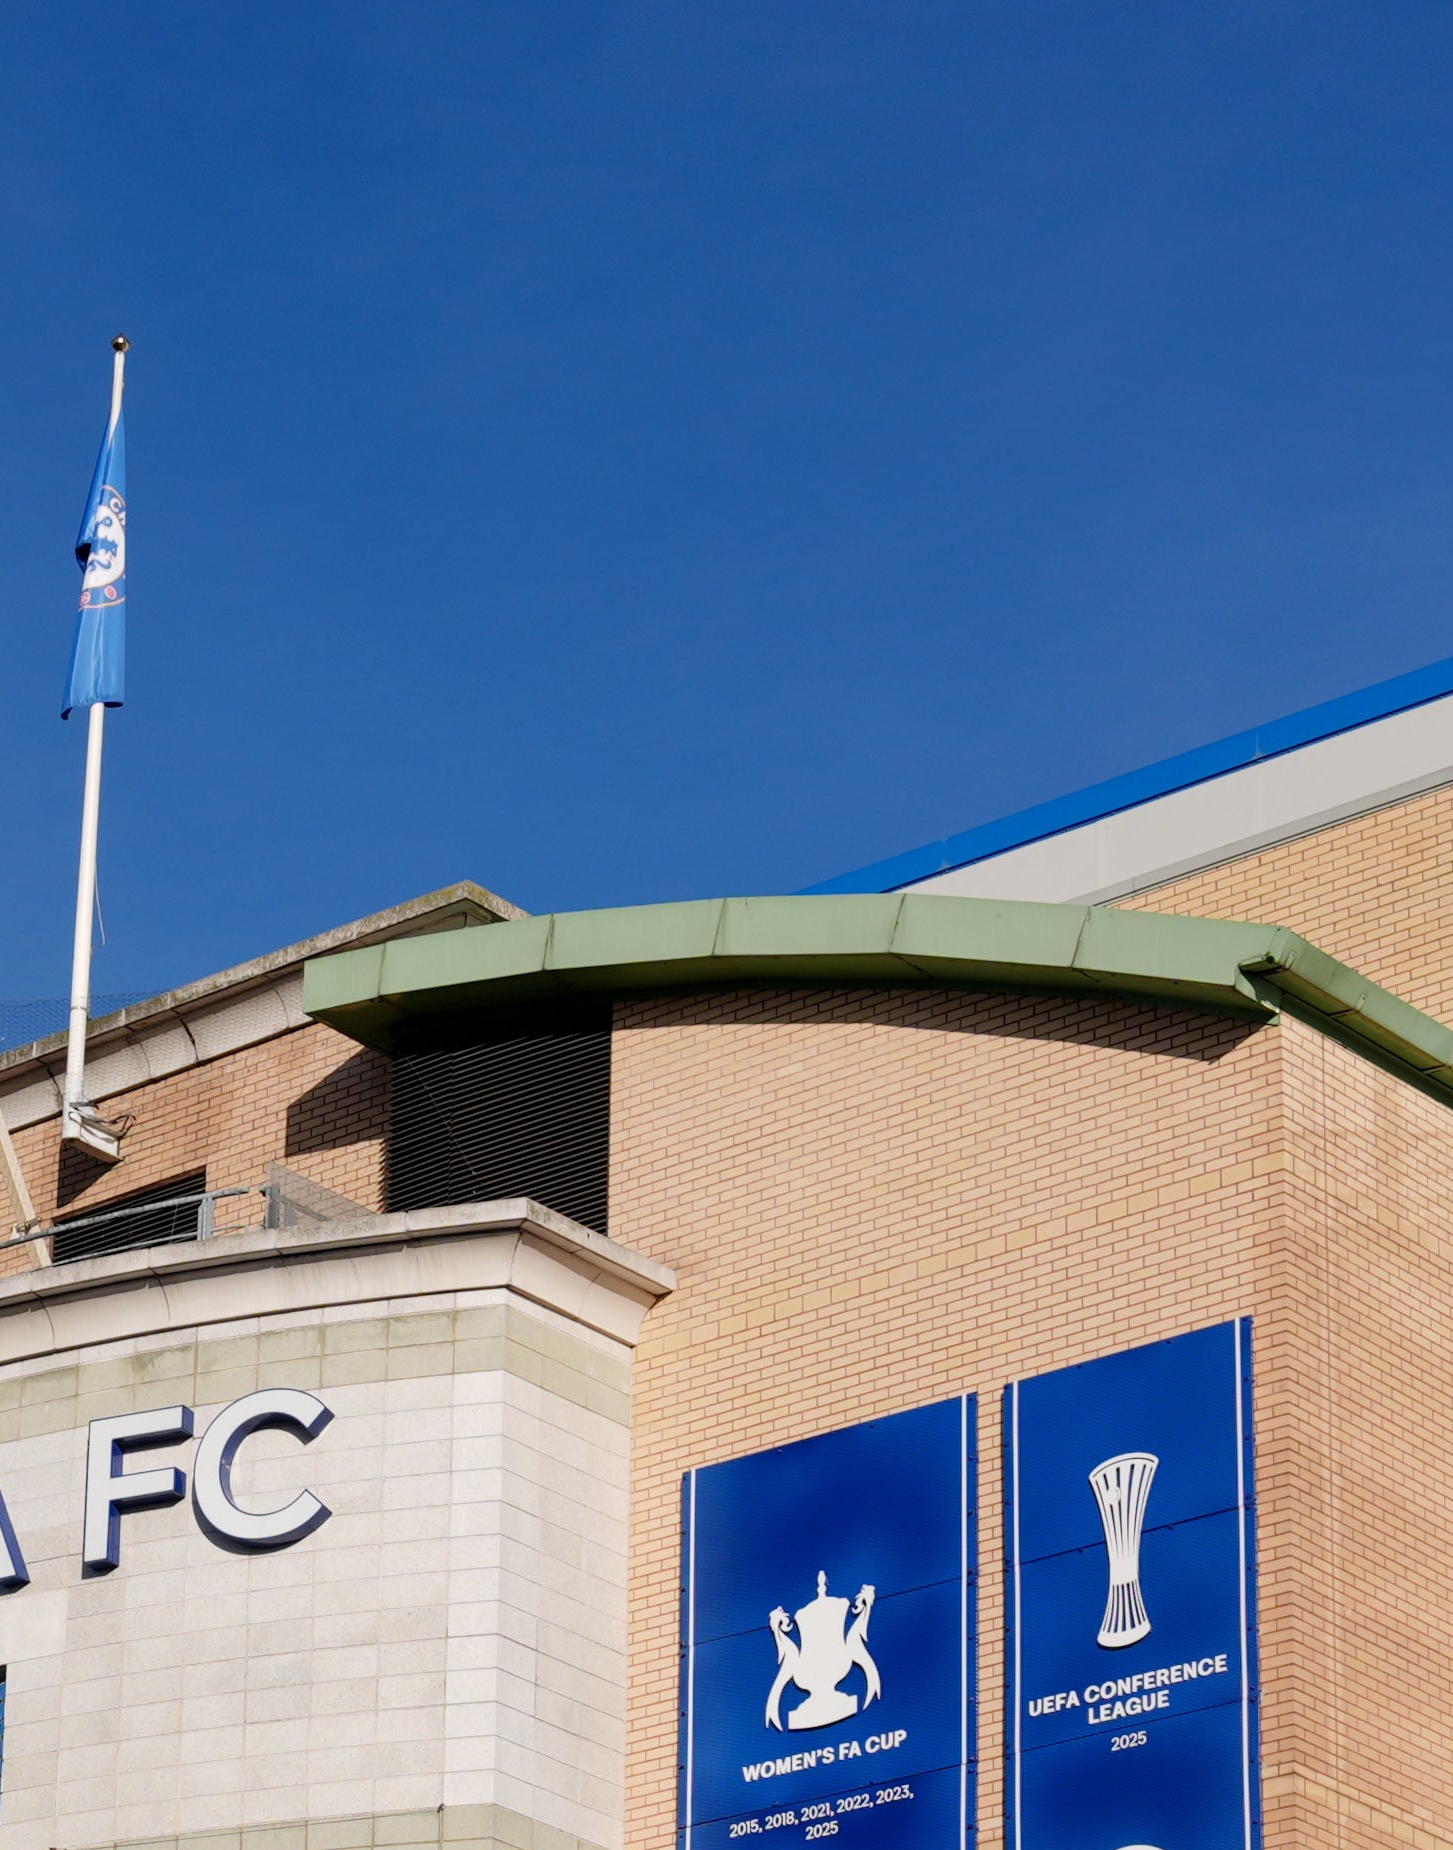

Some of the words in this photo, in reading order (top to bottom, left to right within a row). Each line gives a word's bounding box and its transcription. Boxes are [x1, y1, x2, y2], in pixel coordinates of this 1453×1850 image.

[83, 1387, 335, 1574] FC
[1028, 1690, 1080, 1717] UEFA
[1083, 1654, 1228, 1704] CONFERENCE
[1088, 1690, 1170, 1725] LEAGUE
[742, 1746, 835, 1783] WOMEN'S
[839, 1740, 862, 1760] FA
[865, 1729, 908, 1754] CUP
[1111, 1730, 1148, 1752] 2025
[729, 1819, 763, 1838] 2015,
[764, 1810, 799, 1830] 2018,
[800, 1802, 835, 1822] 2021,
[836, 1794, 874, 1814] 2022,
[876, 1784, 914, 1805] 2023,
[805, 1820, 839, 1840] 2025
